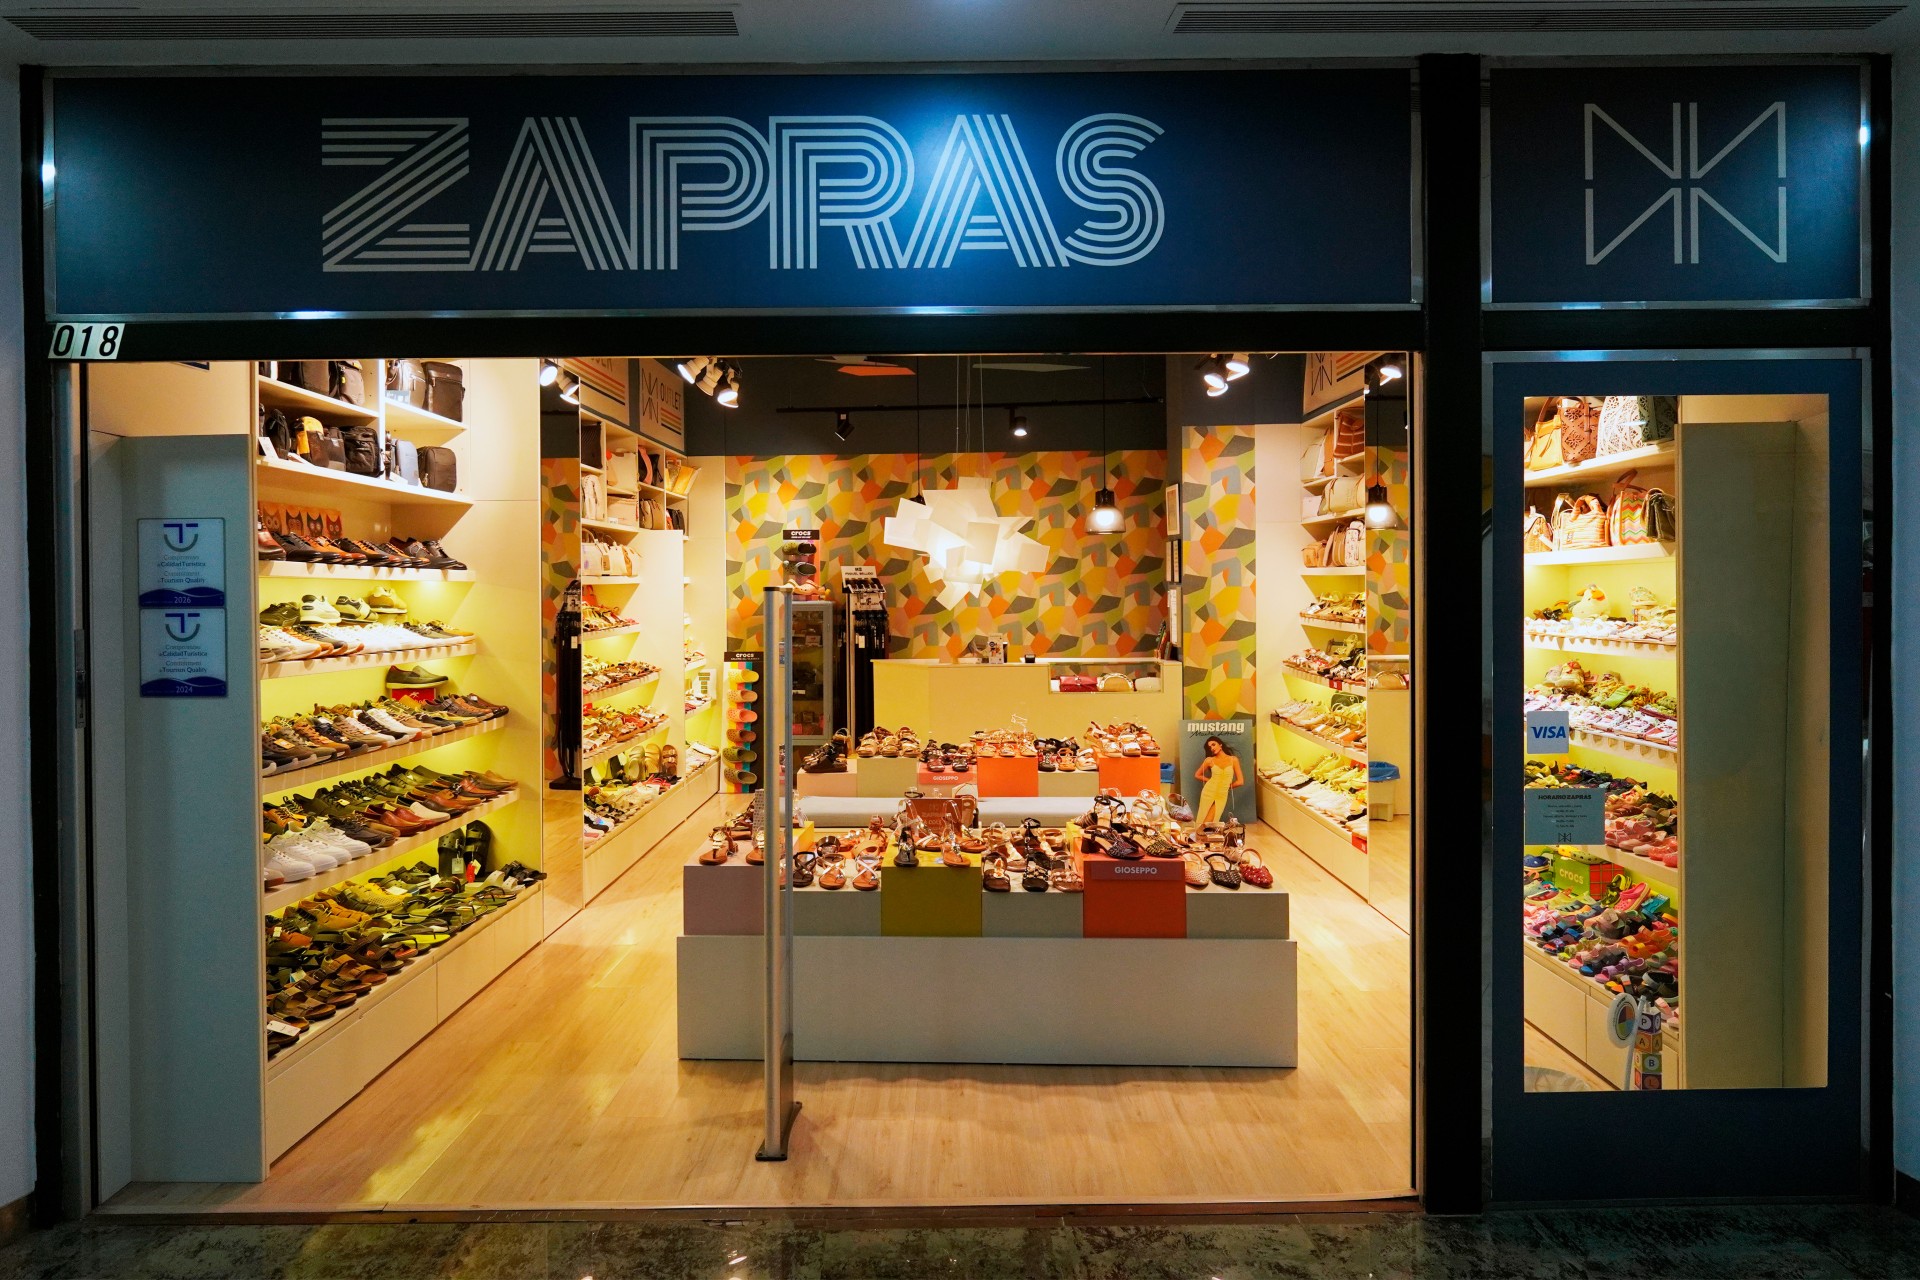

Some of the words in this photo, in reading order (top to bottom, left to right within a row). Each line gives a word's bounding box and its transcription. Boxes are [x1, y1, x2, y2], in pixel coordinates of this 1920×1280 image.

[321, 113, 1165, 272] ZAPRAS
[53, 324, 119, 357] 018
[660, 382, 682, 410] OUTLET
[174, 596, 191, 604] 2026
[176, 686, 193, 694] 2024
[1187, 722, 1245, 733] mustang
[1530, 725, 1566, 739] VISA
[1114, 866, 1158, 875] GIOSEPPO
[1559, 868, 1584, 885] crocs
